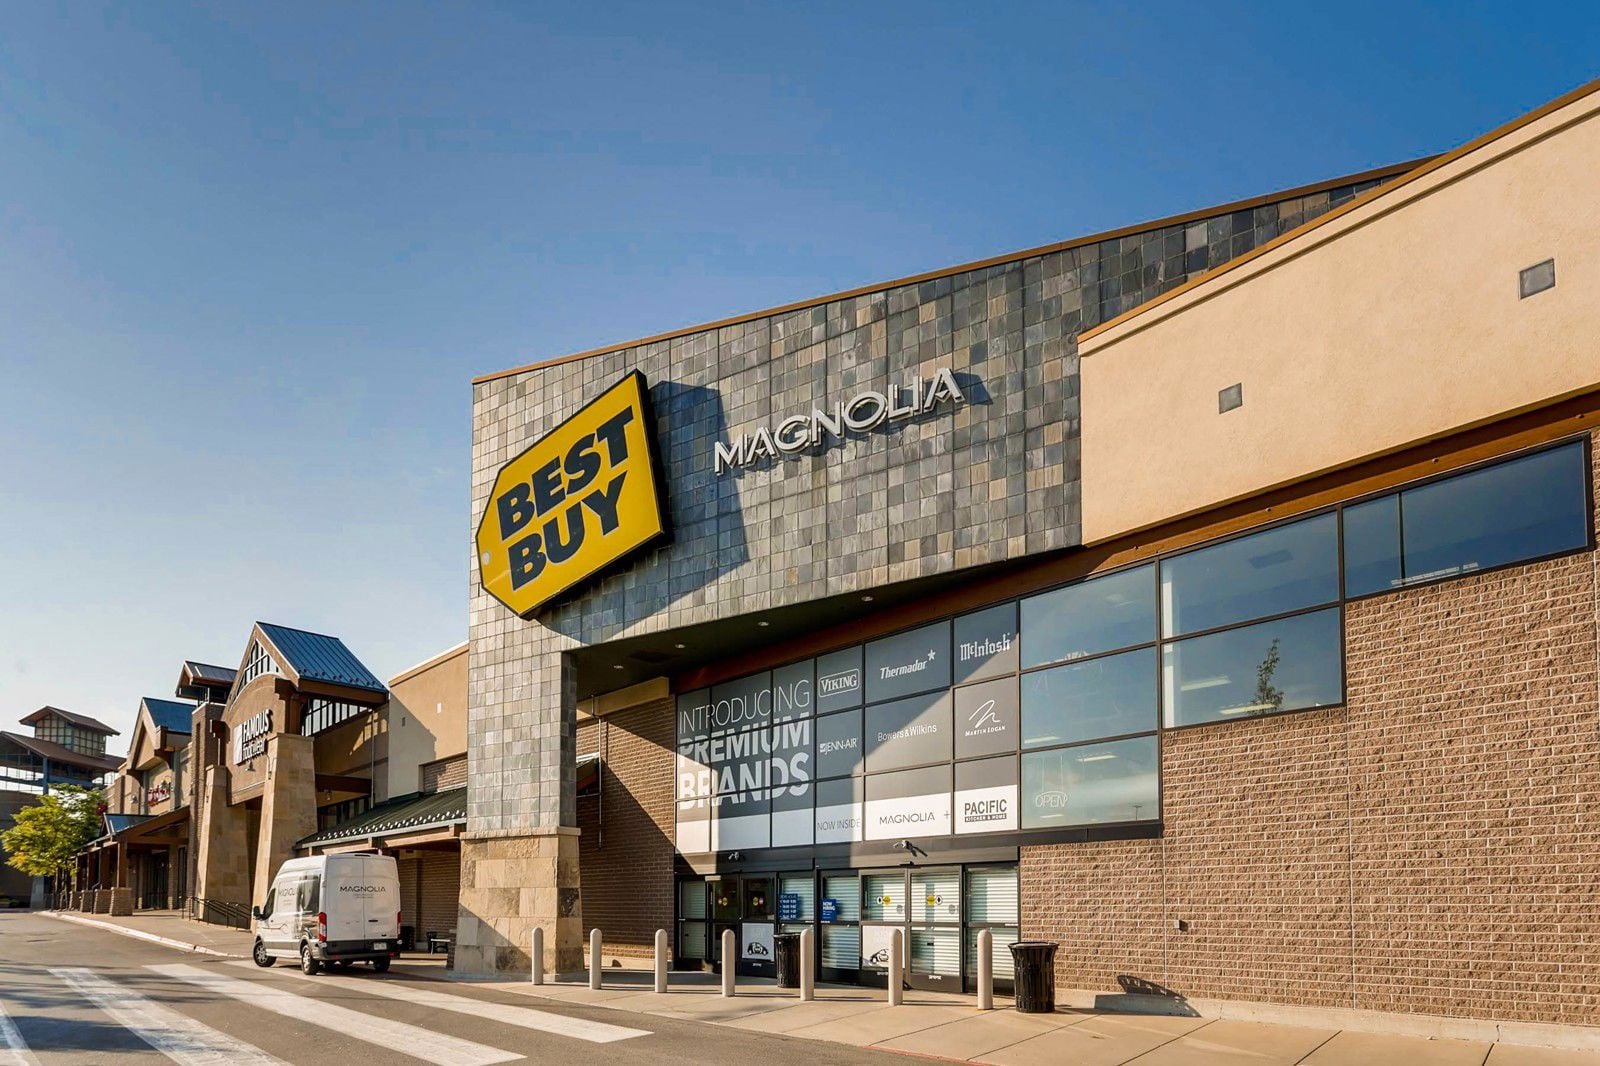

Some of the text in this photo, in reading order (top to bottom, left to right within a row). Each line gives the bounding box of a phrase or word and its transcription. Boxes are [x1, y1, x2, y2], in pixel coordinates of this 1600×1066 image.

[714, 367, 965, 476] MAGNOLIA
[496, 405, 634, 541] BEST
[507, 470, 628, 592] BUY
[960, 634, 1010, 661] McIntosh
[879, 659, 928, 680] Thermador
[820, 674, 858, 693] VIKING
[679, 679, 810, 734] INTRODUCING
[242, 708, 270, 743] FAMOUS
[679, 711, 810, 768] PREMIUM
[679, 752, 810, 810] BRANDS
[964, 799, 1007, 815] PACIFIC
[1035, 792, 1068, 808] OPEN
[817, 818, 861, 831] NOW INSIDE
[879, 811, 936, 825] MAGNOLIA
[339, 885, 386, 893] MAGNOLIA
